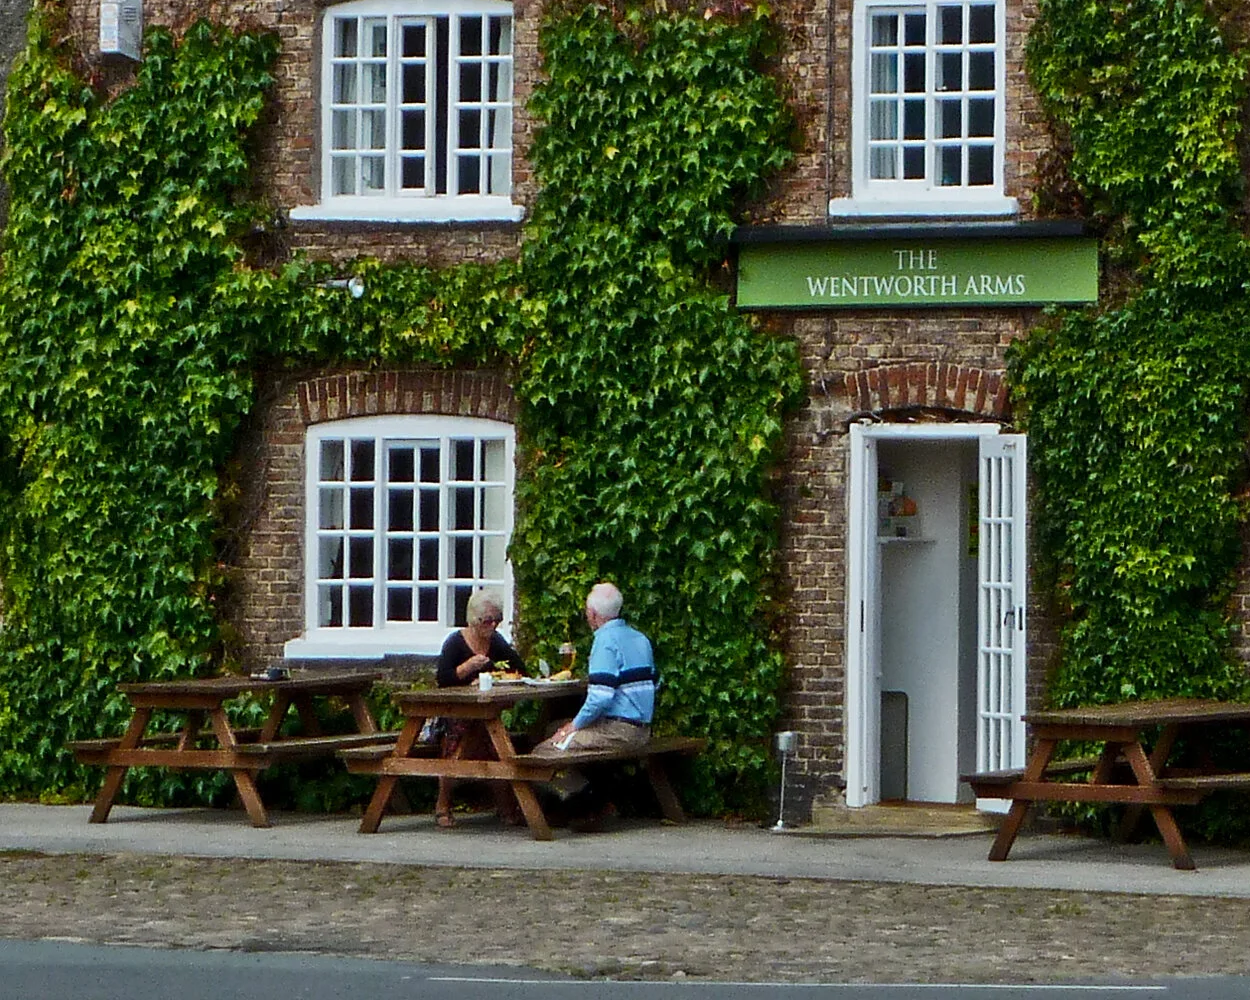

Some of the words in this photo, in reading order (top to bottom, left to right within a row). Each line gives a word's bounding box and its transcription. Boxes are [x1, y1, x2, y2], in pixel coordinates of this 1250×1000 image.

[894, 249, 937, 270] THE
[805, 275, 957, 297] WENTWORTH
[963, 274, 1025, 296] ARMS
